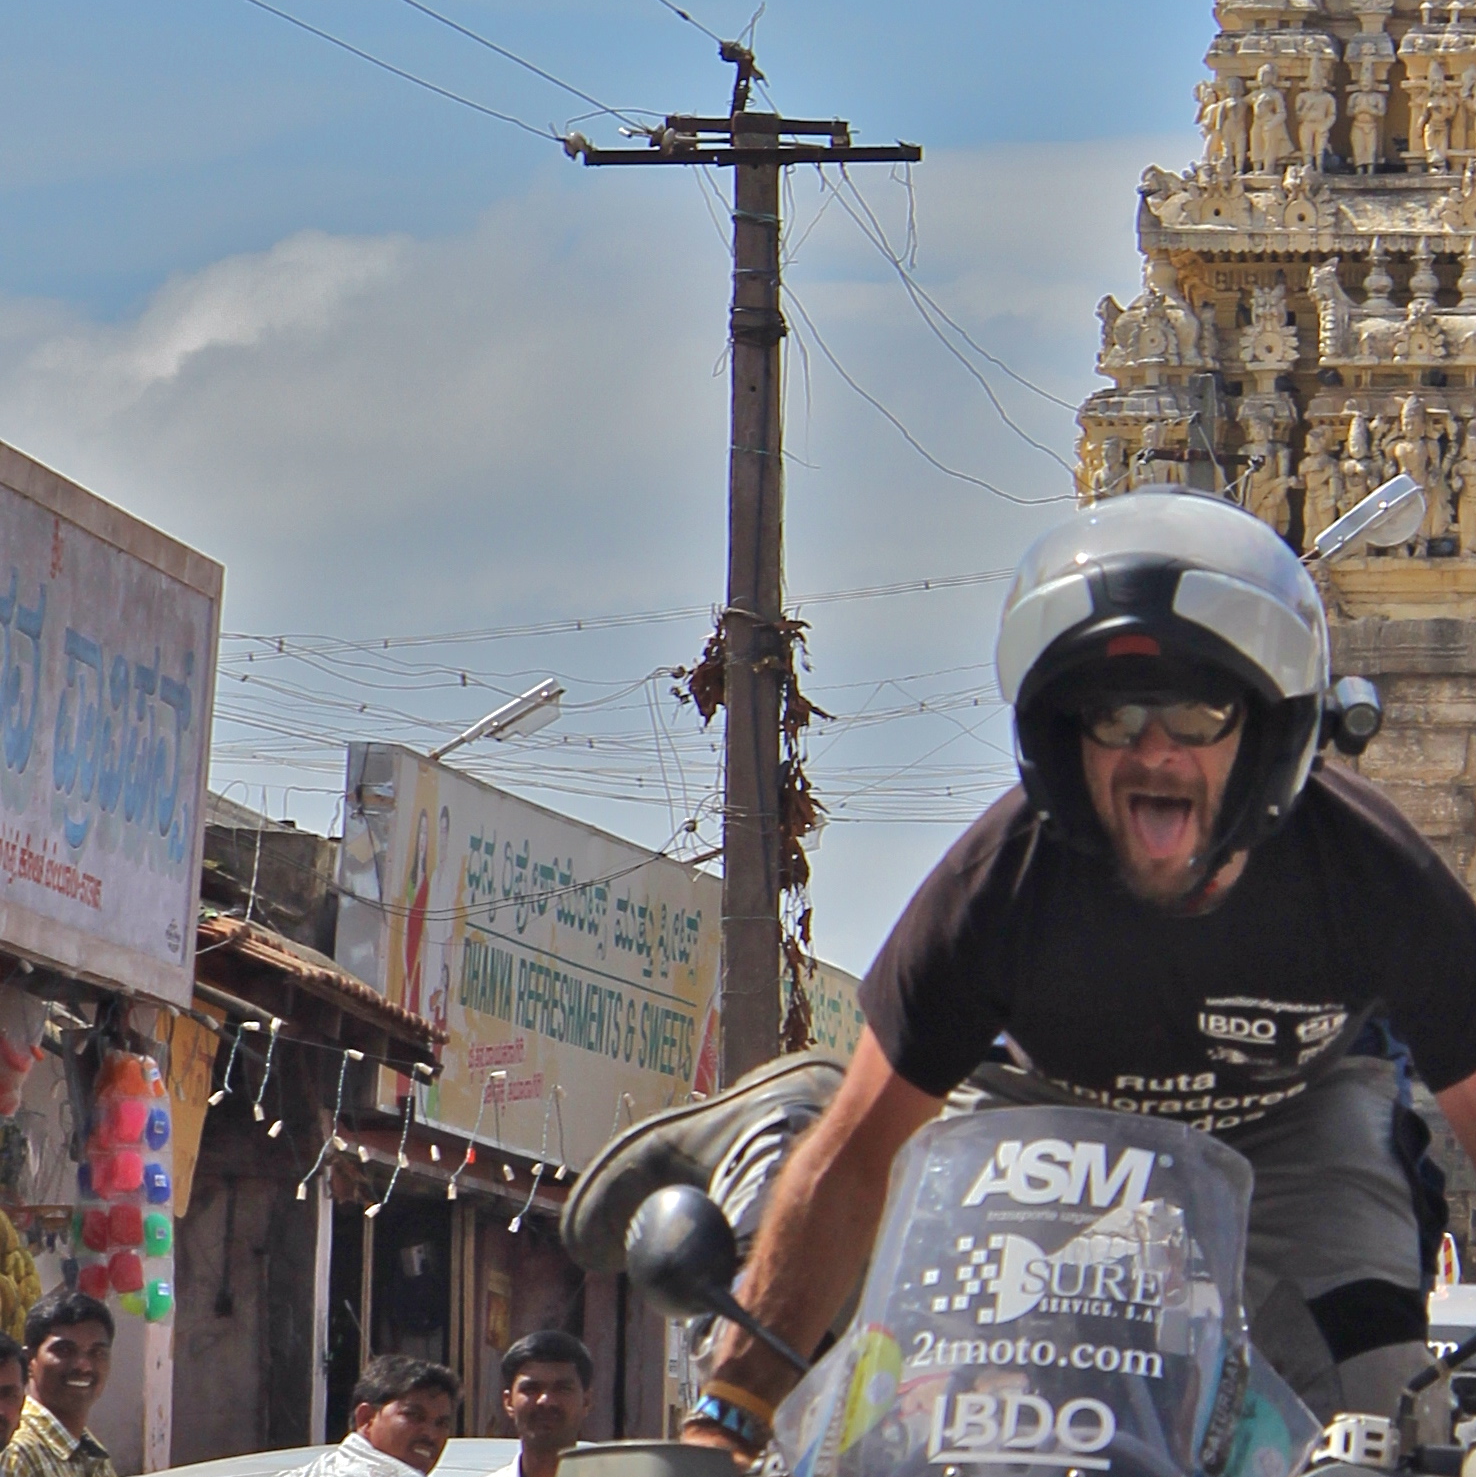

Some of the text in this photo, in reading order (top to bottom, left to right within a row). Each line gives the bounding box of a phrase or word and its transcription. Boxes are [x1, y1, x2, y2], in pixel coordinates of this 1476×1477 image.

[460, 937, 514, 1023] DHANYA
[516, 957, 623, 1060] REFRESHMENTS
[624, 999, 636, 1064] &
[638, 1001, 695, 1083] SWEETS
[1208, 1015, 1277, 1039] BDO
[1115, 1073, 1216, 1092] Ruta
[961, 1137, 1155, 1211] ASM
[1021, 1257, 1163, 1305] SURE
[912, 1330, 1164, 1379] 2tmoto.com
[955, 1392, 1116, 1456] BDO
